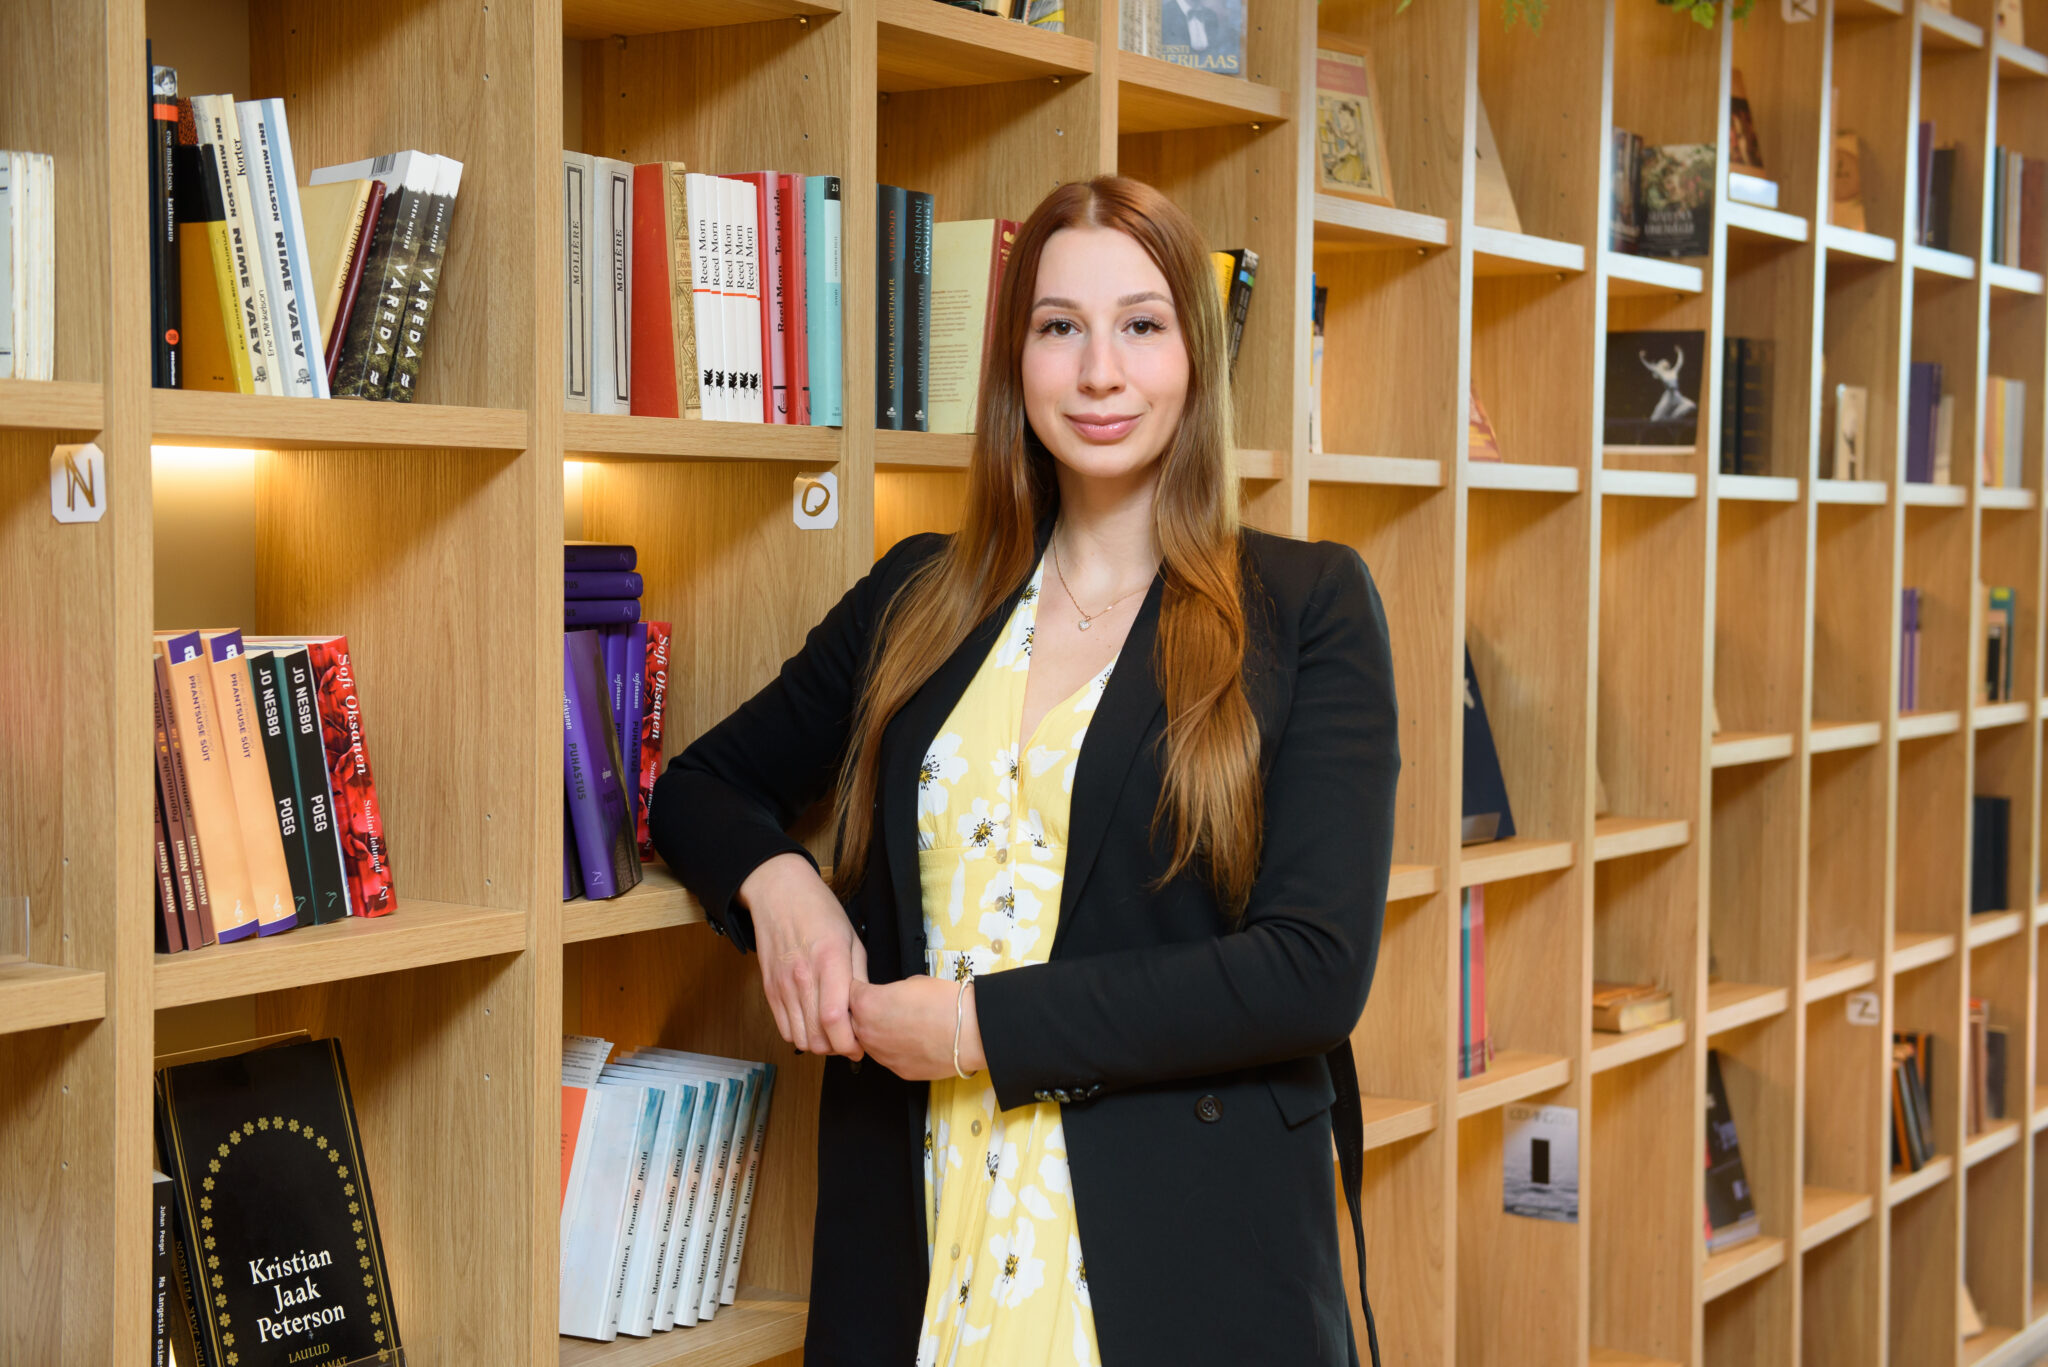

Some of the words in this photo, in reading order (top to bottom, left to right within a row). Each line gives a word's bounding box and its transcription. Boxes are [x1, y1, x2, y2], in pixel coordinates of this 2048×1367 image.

[258, 122, 267, 146] ENE
[233, 138, 246, 177] Korter
[262, 149, 280, 222] MIHKELSON
[831, 183, 839, 192] 23
[410, 199, 420, 219] SVEN
[436, 202, 445, 223] SVEN
[214, 117, 224, 141] ENE
[219, 144, 237, 218] MIHKELSON
[232, 227, 250, 289] NIME
[244, 297, 263, 355] VAEV
[403, 221, 415, 250] MIKSER
[429, 224, 441, 253] MIKSER
[724, 224, 732, 255] Morn
[735, 225, 743, 256] Morn
[913, 200, 923, 274] PÕGENEMINE
[275, 231, 293, 292] NIME
[700, 255, 709, 285] Reed
[712, 257, 721, 287] Reed
[725, 260, 734, 289] Reed
[736, 260, 745, 289] Reed
[746, 261, 755, 290] Reed
[258, 289, 273, 338] Mihkelson
[375, 264, 408, 355] VAREDA
[405, 267, 436, 358] VAREDA
[777, 300, 785, 333] Reed
[888, 278, 896, 338] MORTIMER
[287, 298, 305, 358] VAEV
[267, 340, 275, 357] Ene
[65, 450, 96, 512] N
[801, 481, 831, 517] O
[653, 634, 669, 666] Sofi
[259, 668, 273, 686] JO
[292, 667, 306, 684] JO
[336, 653, 354, 690] Sofi
[188, 675, 206, 737] PRANTSUSE
[200, 738, 211, 762] SÜIT
[230, 673, 247, 734] PRANTSUSE
[241, 735, 252, 759] SÜIT
[262, 688, 281, 737] NESBØ
[295, 686, 314, 735] NESBØ
[652, 671, 667, 741] Oksanen
[158, 731, 166, 743] la
[160, 745, 168, 753] a
[345, 694, 366, 776] Oksanen
[631, 721, 639, 773] PUHASTUS
[162, 755, 180, 823] Popmuusika
[568, 742, 587, 801] PUHASTUS
[278, 797, 296, 836] POEG
[310, 794, 328, 833] POEG
[363, 799, 377, 834] Stalini
[157, 841, 169, 874] Niemi
[175, 840, 189, 872] Niemi
[189, 835, 201, 867] Niemi
[369, 836, 384, 873] lehmad
[162, 876, 176, 913] Mikael
[181, 875, 196, 911] Mikael
[195, 869, 208, 905] Mikael
[697, 1231, 712, 1285] Maeterlinck
[708, 1176, 722, 1224] Pirandello
[718, 1139, 729, 1170] Brecht
[713, 1226, 728, 1279] Maeterlinck
[725, 1172, 739, 1218] Pirandello
[735, 1135, 746, 1165] Brecht
[732, 1213, 747, 1265] Maeterlinck
[743, 1159, 757, 1205] Pirandello
[753, 1124, 764, 1153] Brecht
[615, 1244, 631, 1299] Maeterlinck
[627, 1189, 642, 1236] Pirandello
[637, 1151, 649, 1181] Brecht
[651, 1241, 666, 1296] Maeterlinck
[662, 1185, 676, 1233] Pirandello
[672, 1148, 684, 1178] Brecht
[672, 1236, 687, 1290] Maeterlinck
[683, 1181, 698, 1228] Pirandello
[694, 1144, 705, 1174] Brecht
[158, 1230, 166, 1257] Peegel
[158, 1276, 166, 1289] Ma
[248, 1249, 333, 1285] Kristian
[156, 1291, 167, 1335] langesin
[273, 1276, 322, 1315] Jaak
[256, 1303, 346, 1344] Peterson
[157, 1338, 165, 1367] esime
[288, 1343, 330, 1365] LAULUD
